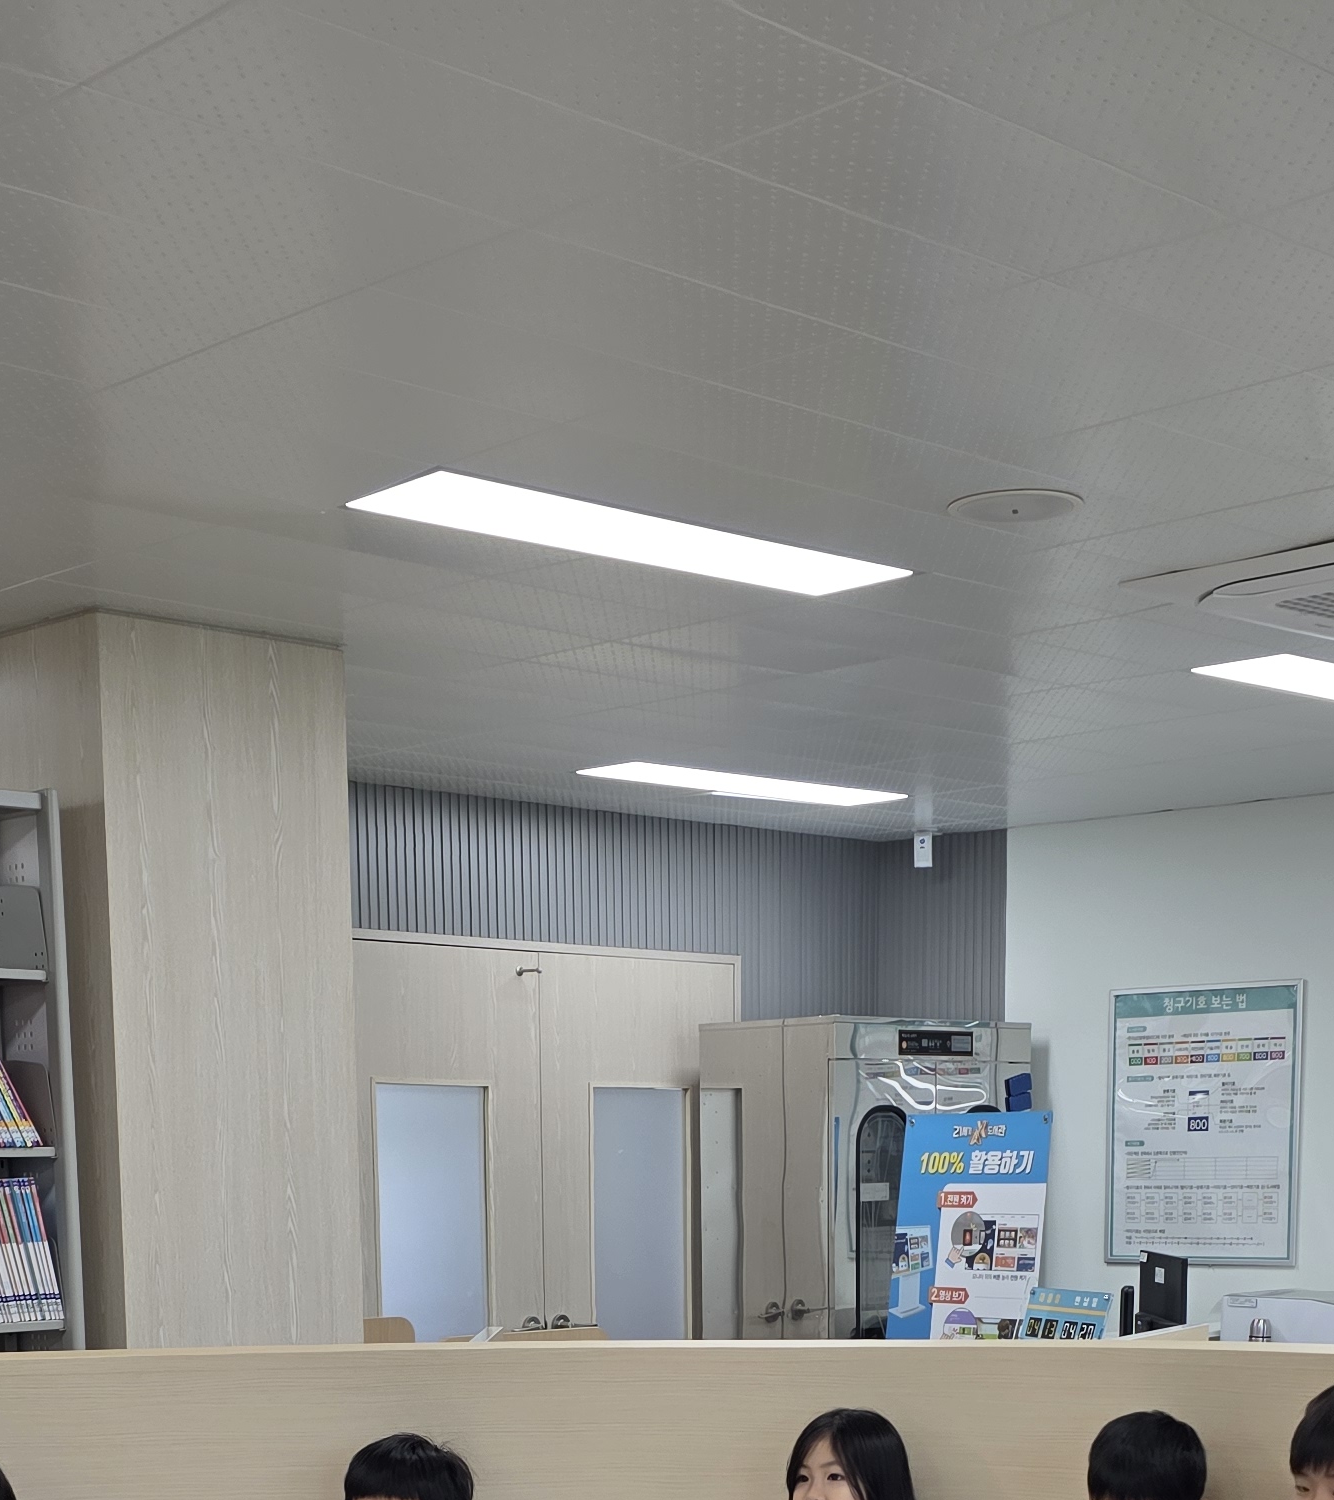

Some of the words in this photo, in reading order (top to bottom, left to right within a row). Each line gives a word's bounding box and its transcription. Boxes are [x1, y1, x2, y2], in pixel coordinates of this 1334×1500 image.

[1163, 996, 1207, 1012] 청구기호
[1211, 995, 1233, 1009] 보는
[1236, 993, 1247, 1009] 법
[1190, 1119, 1208, 1130] 800
[920, 1151, 965, 1174] 100%
[969, 1149, 1034, 1174] 활용하기
[952, 1290, 965, 1302] 보기
[1027, 1319, 1040, 1336] 04
[1044, 1320, 1056, 1336] 13
[1061, 1322, 1075, 1339] 04
[1079, 1324, 1095, 1340] 20
